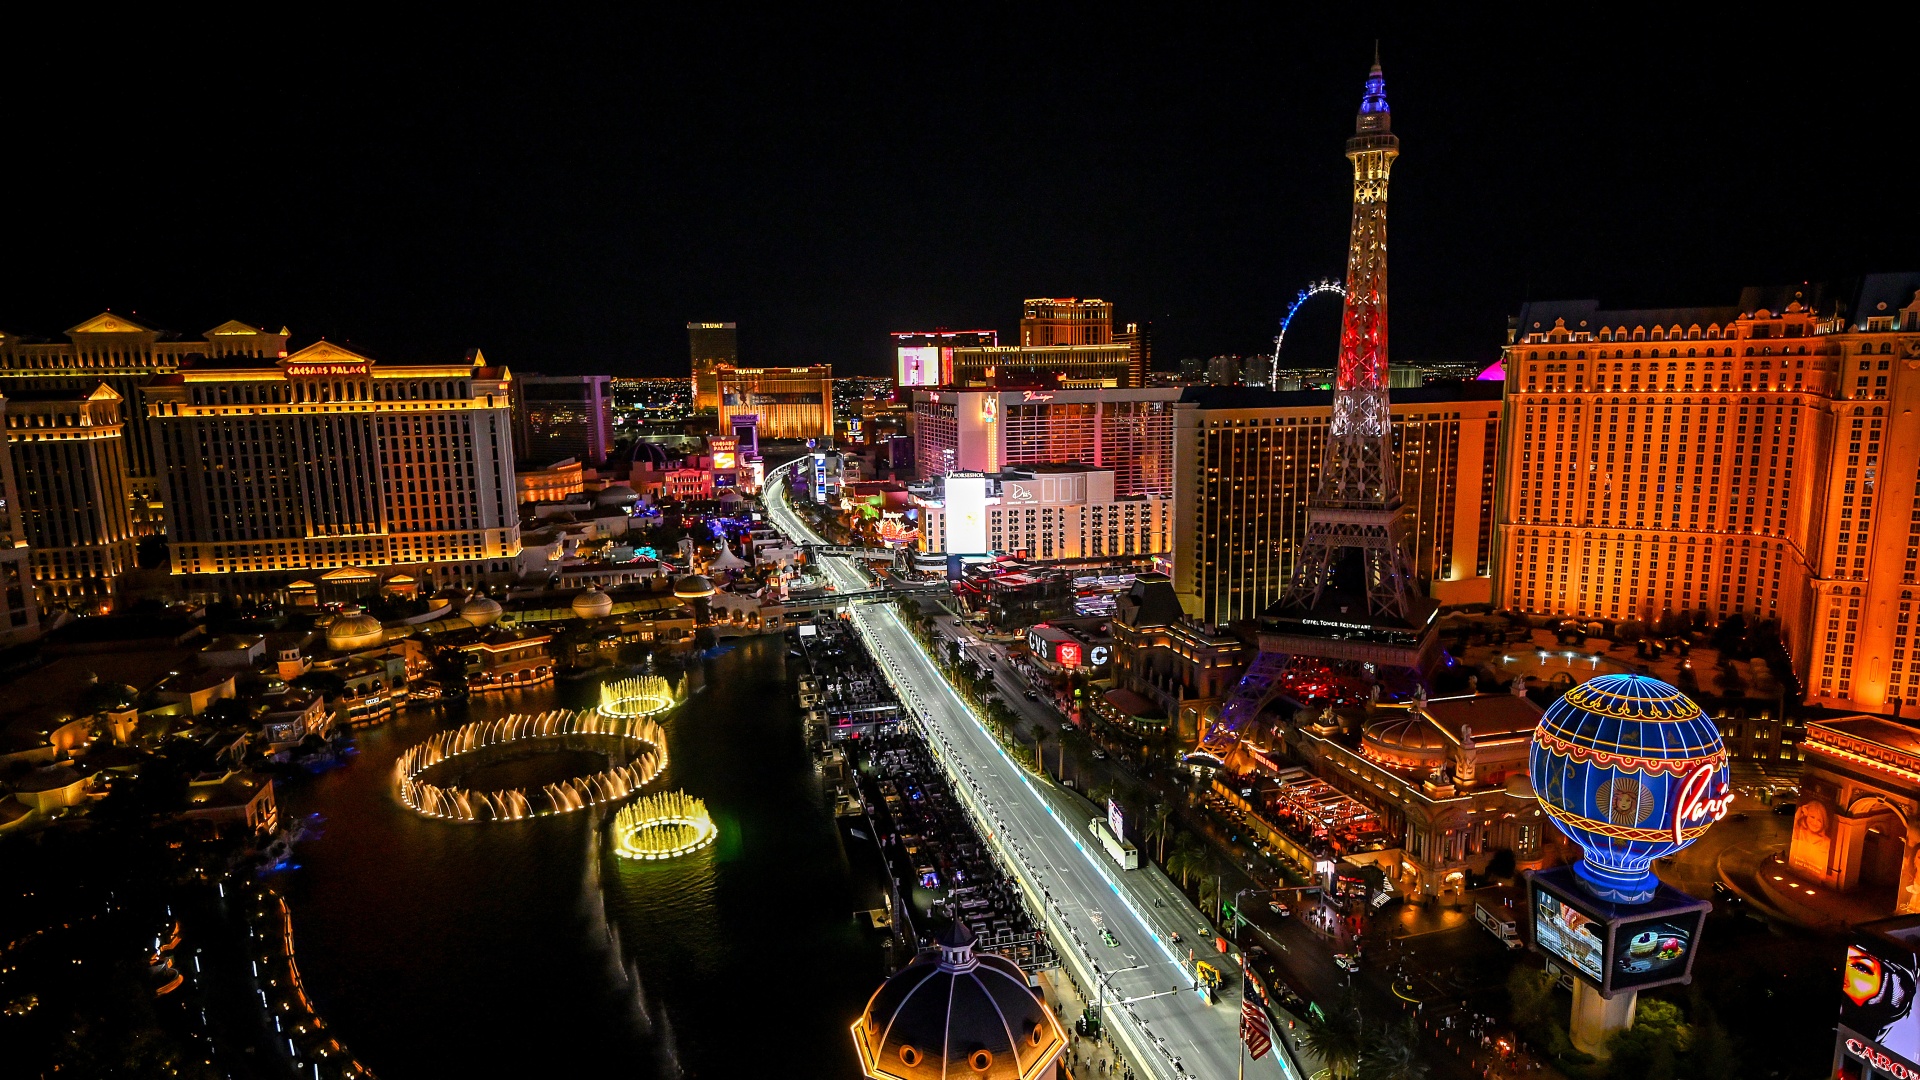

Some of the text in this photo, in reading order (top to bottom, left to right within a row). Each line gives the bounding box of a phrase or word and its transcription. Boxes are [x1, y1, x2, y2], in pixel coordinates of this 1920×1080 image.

[983, 345, 1020, 353] VENETIAN
[287, 365, 367, 375] CAESARS PALACE
[1302, 618, 1371, 630] EIFFEL TOWER RESTAURANT
[1028, 631, 1048, 659] CVS
[1675, 763, 1735, 846] Paris
